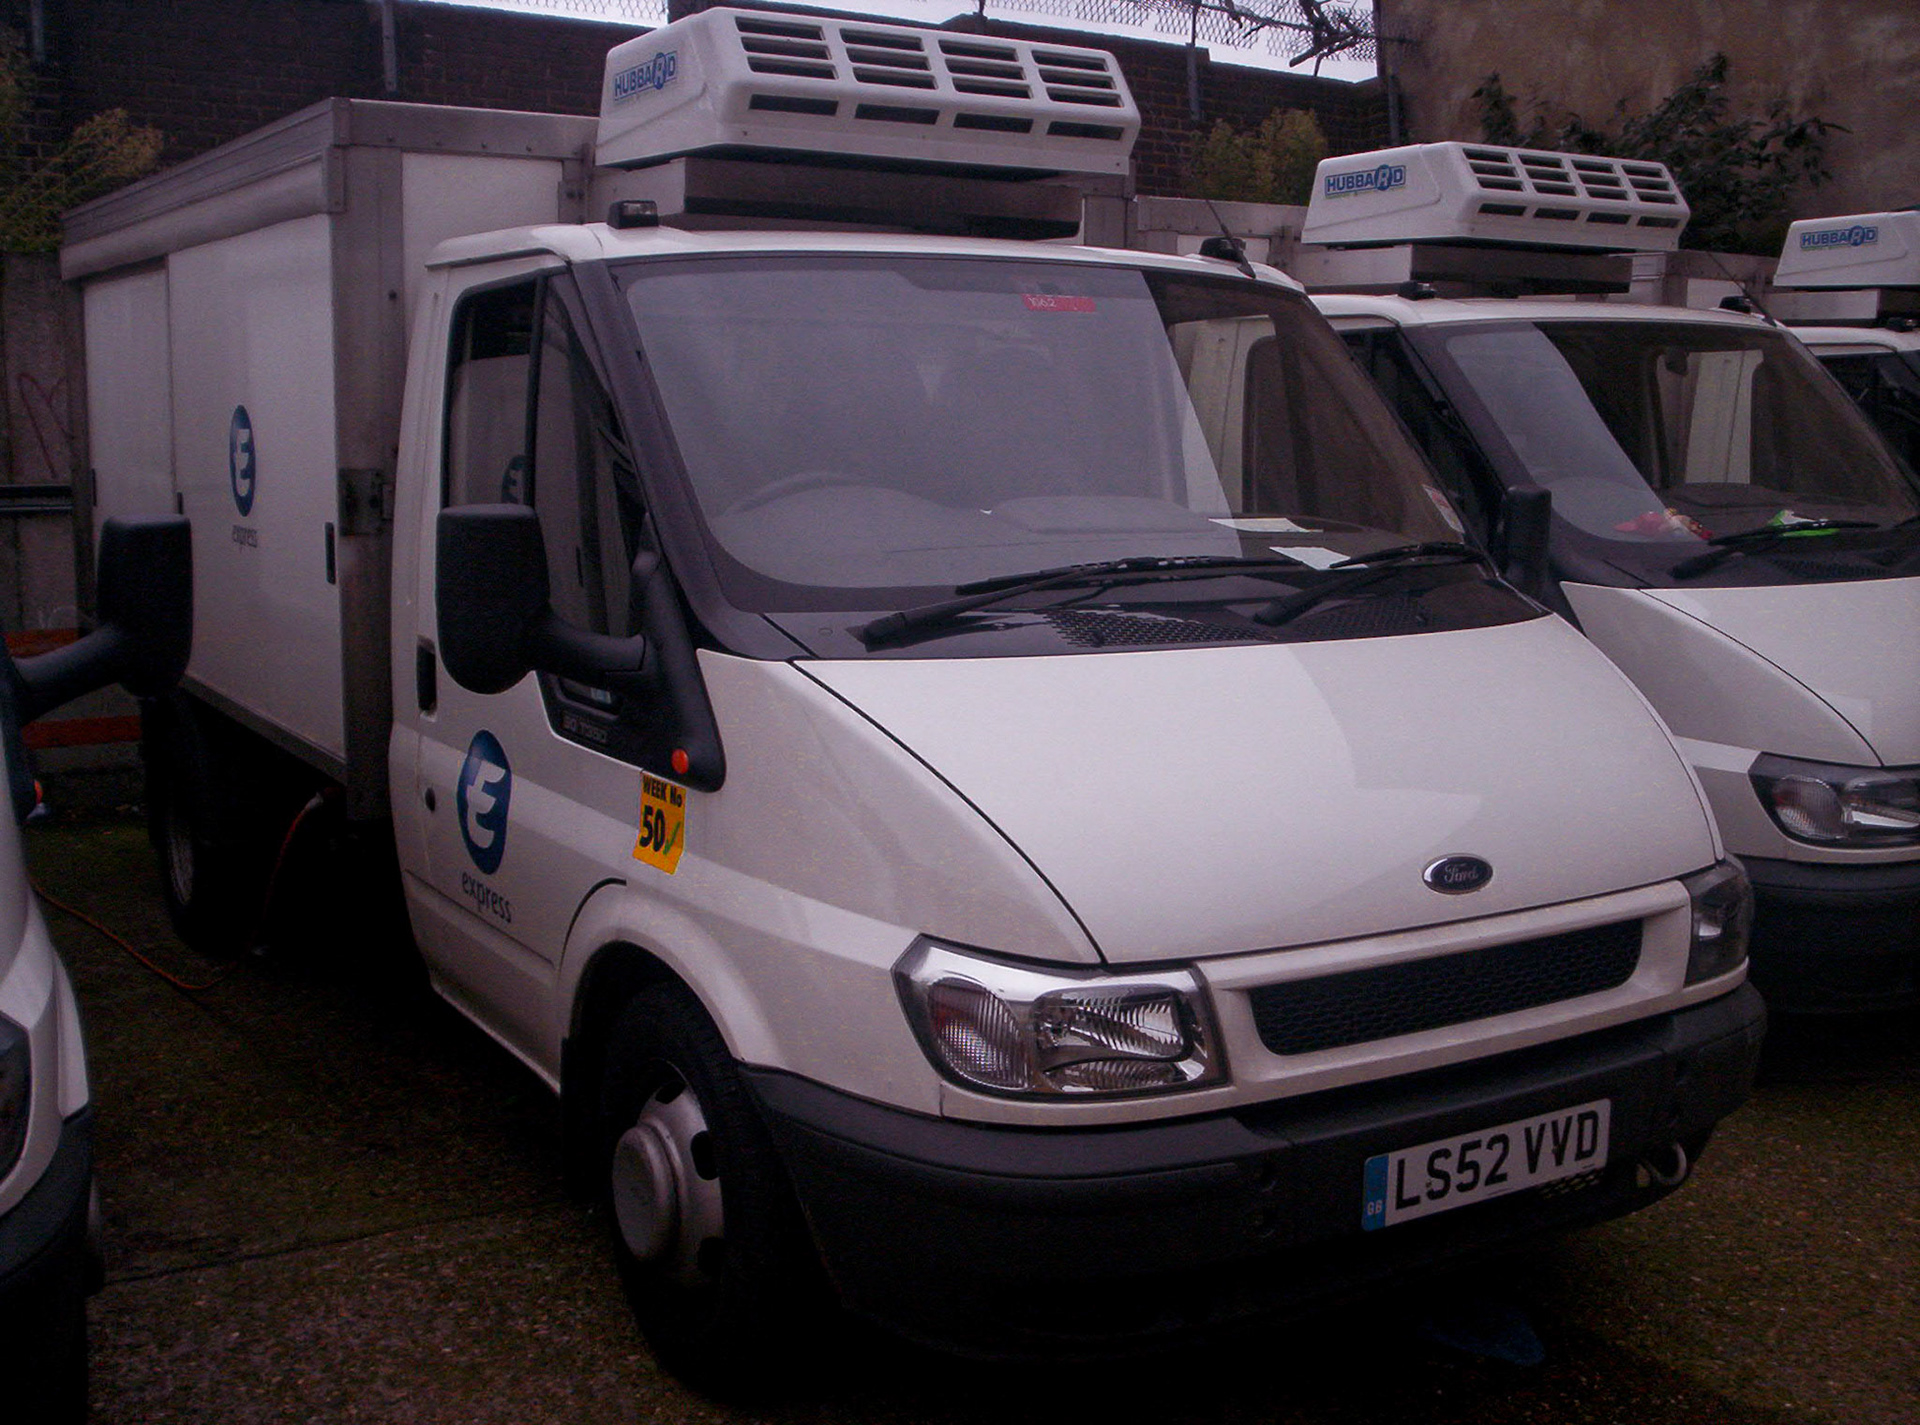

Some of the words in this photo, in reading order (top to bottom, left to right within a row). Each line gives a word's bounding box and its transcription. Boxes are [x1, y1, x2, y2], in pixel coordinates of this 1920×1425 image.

[614, 52, 677, 97] HUBBARD
[1327, 165, 1404, 193] HUBBARD
[1801, 225, 1876, 247] HUBBARD
[643, 775, 667, 803] WEEK
[639, 804, 666, 852] 50
[1443, 862, 1480, 884] Ford
[462, 871, 511, 923] express
[1396, 1133, 1510, 1210] LS52
[1523, 1110, 1600, 1175] VVD
